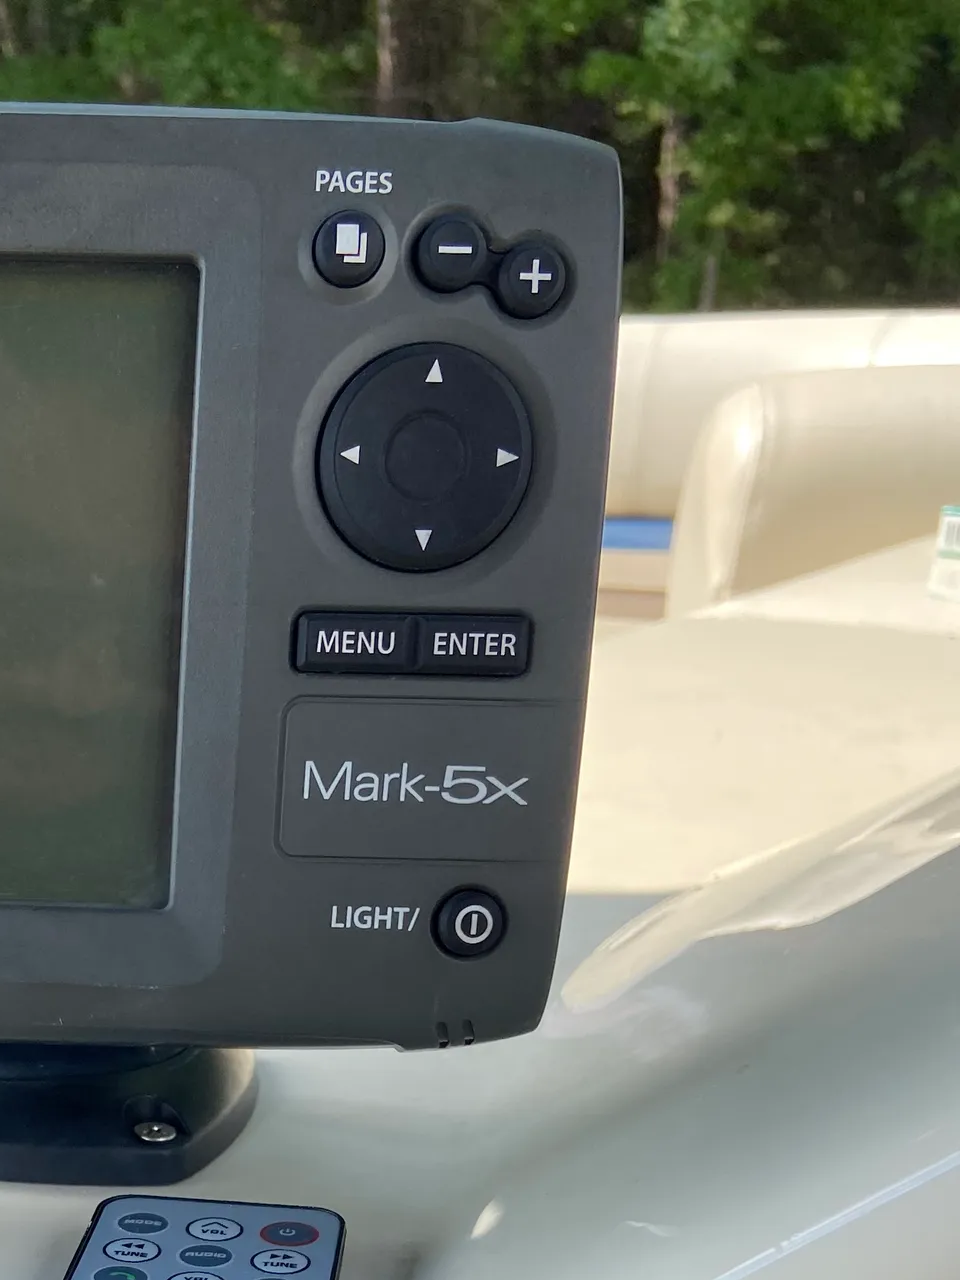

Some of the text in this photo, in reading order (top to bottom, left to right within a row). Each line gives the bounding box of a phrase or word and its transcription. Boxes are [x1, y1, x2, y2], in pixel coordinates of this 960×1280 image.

[315, 170, 393, 195] PAGES
[316, 630, 396, 655] MENU
[433, 632, 517, 656] ENTER
[303, 760, 529, 806] Mark-5x
[330, 905, 420, 931] LIGHT/
[124, 1218, 162, 1227] MODE
[201, 1228, 228, 1236] VOL
[114, 1250, 149, 1258] TUNE
[262, 1261, 299, 1269] TUNE
